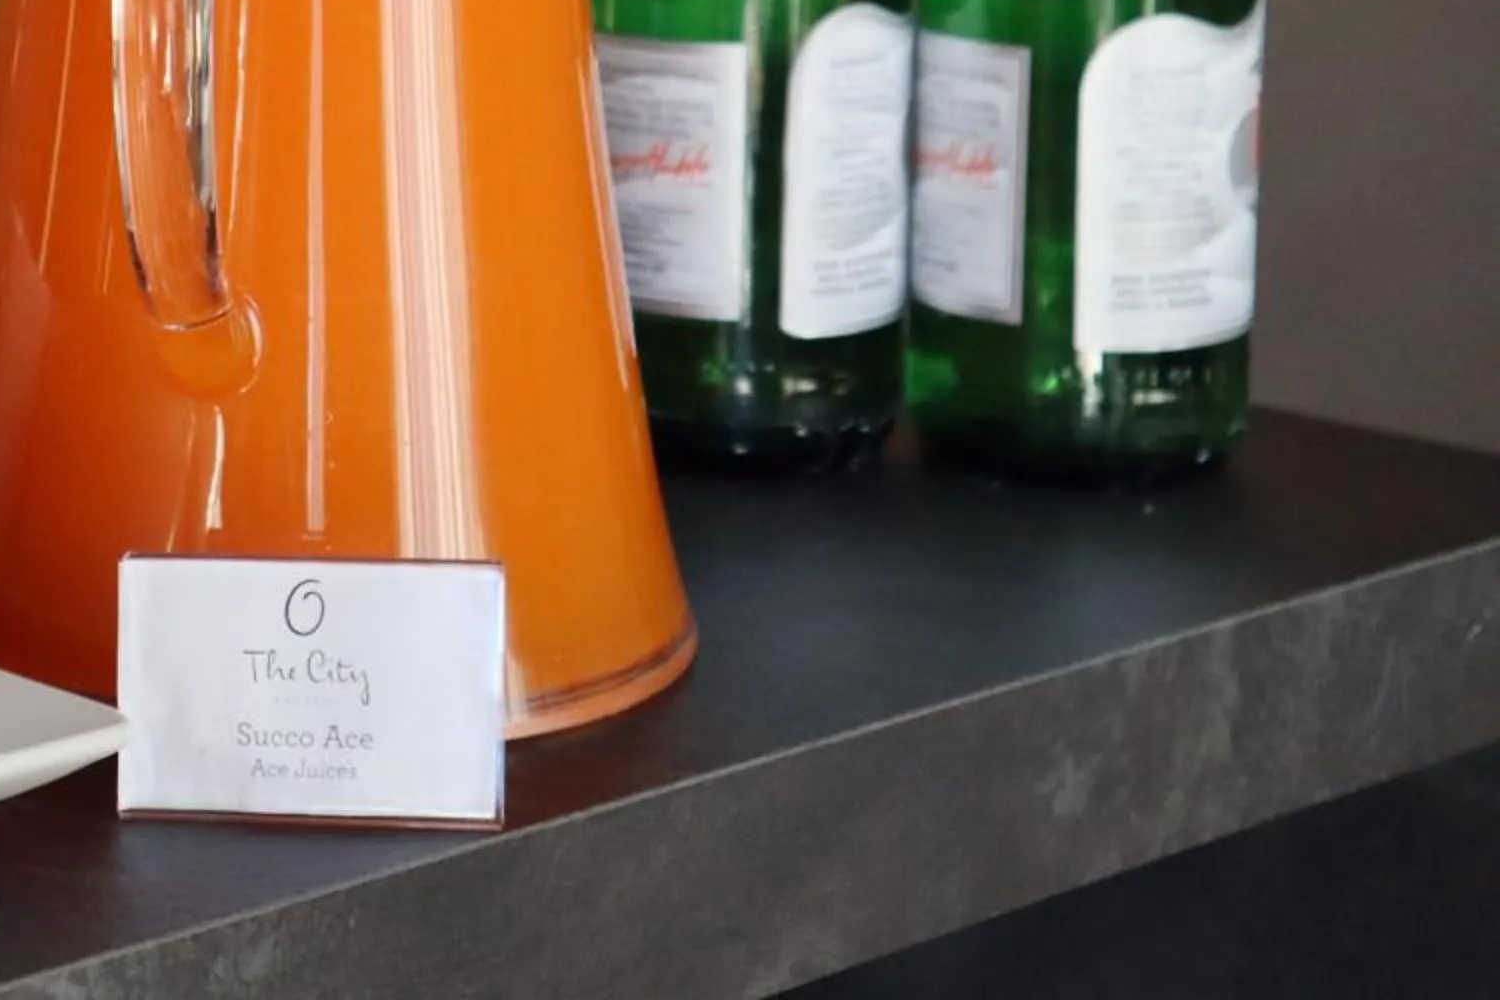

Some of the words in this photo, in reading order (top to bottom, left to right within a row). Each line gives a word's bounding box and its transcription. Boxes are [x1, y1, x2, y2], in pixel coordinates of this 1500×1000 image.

[243, 649, 297, 683] The
[307, 649, 371, 706] City
[237, 721, 314, 748] Succo
[323, 724, 375, 750] Ace
[250, 758, 289, 779] Ace
[294, 758, 358, 780] Juices
